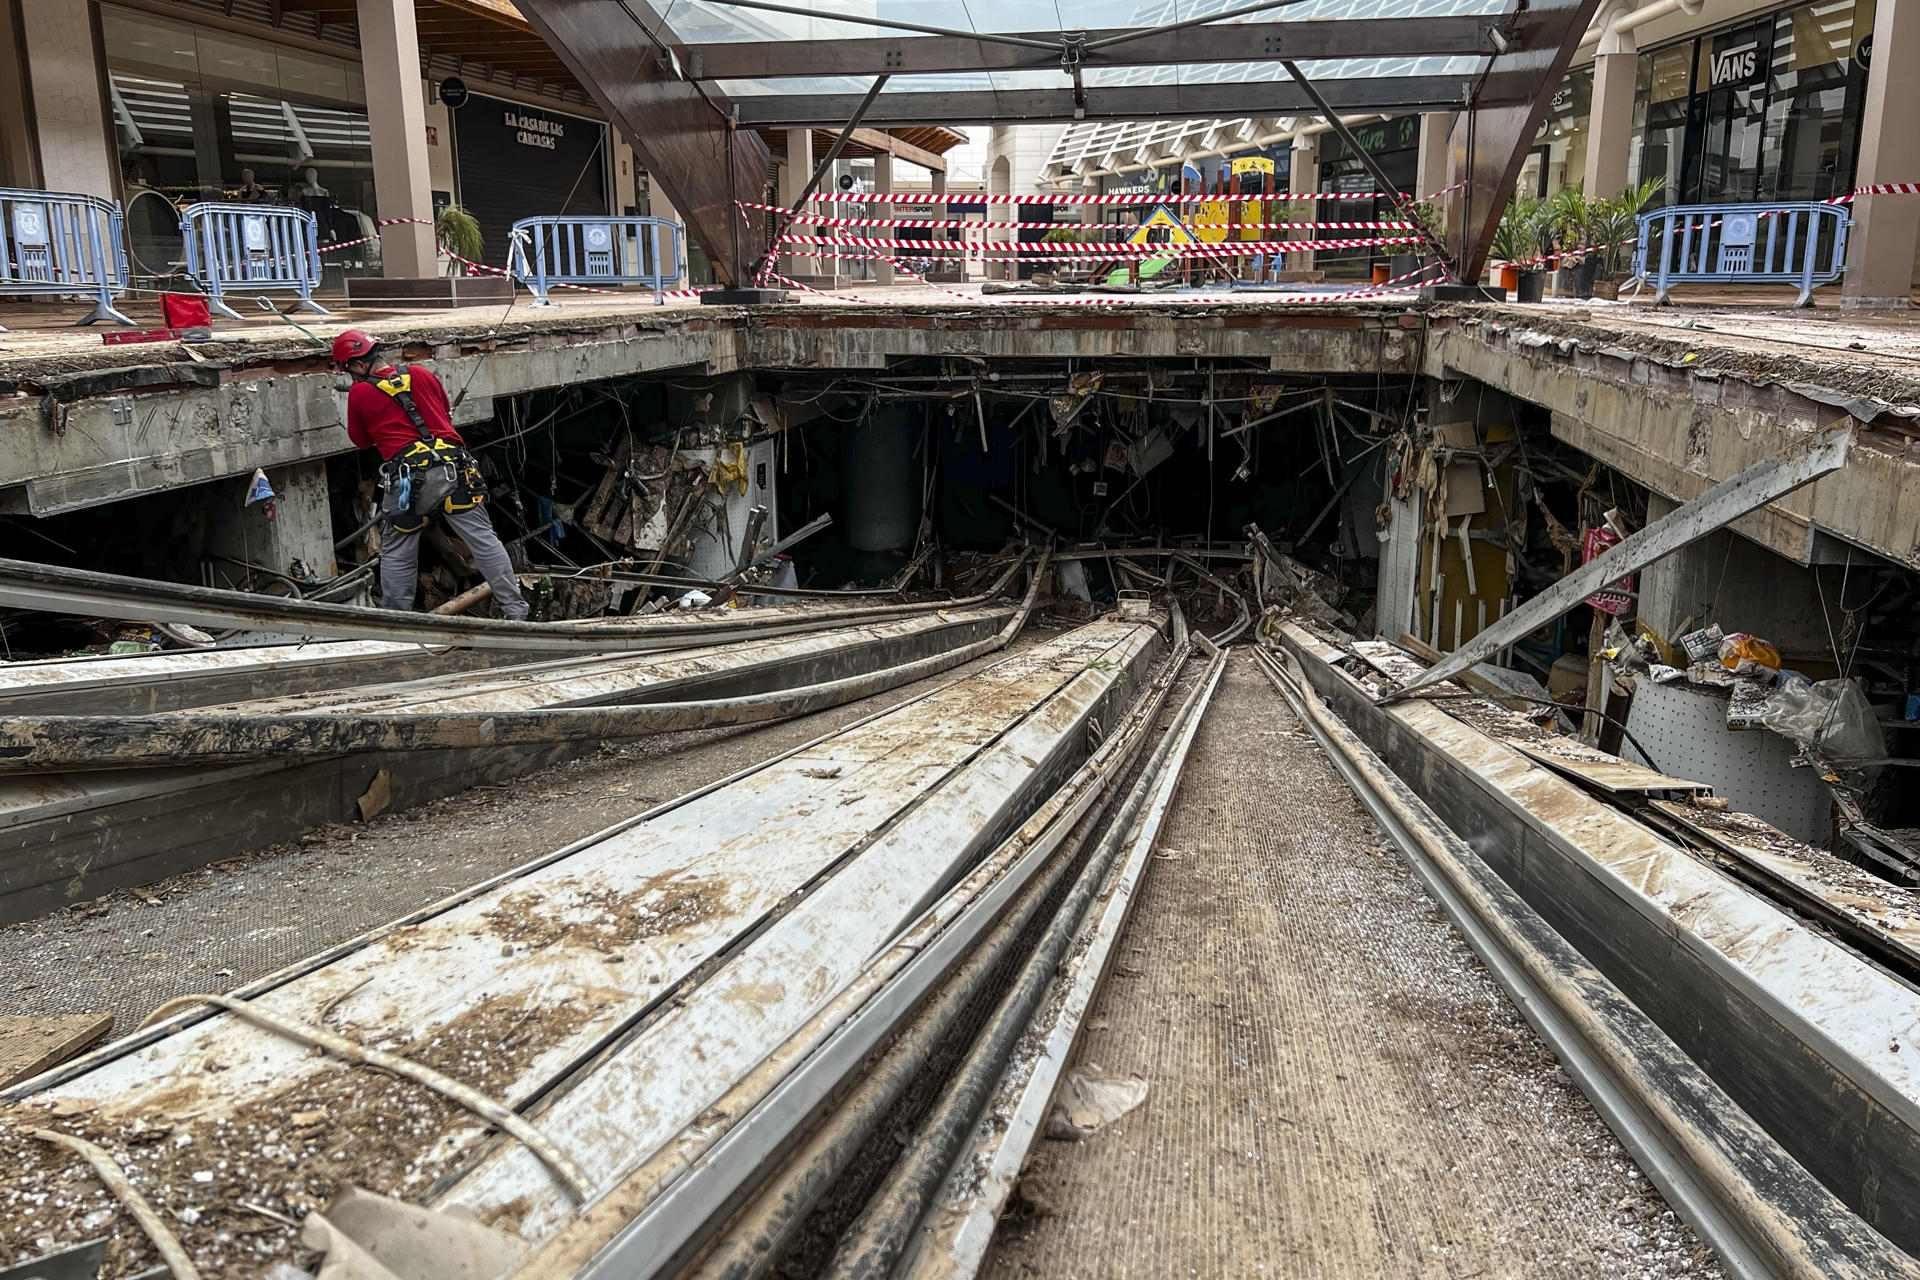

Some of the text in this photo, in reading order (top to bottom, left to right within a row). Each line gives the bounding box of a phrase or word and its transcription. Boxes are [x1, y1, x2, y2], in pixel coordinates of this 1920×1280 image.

[1710, 41, 1758, 85] VANS
[504, 112, 564, 137] LA CASA DE LAS
[517, 131, 556, 150] CARCASAS
[1108, 185, 1150, 196] HAWKERS
